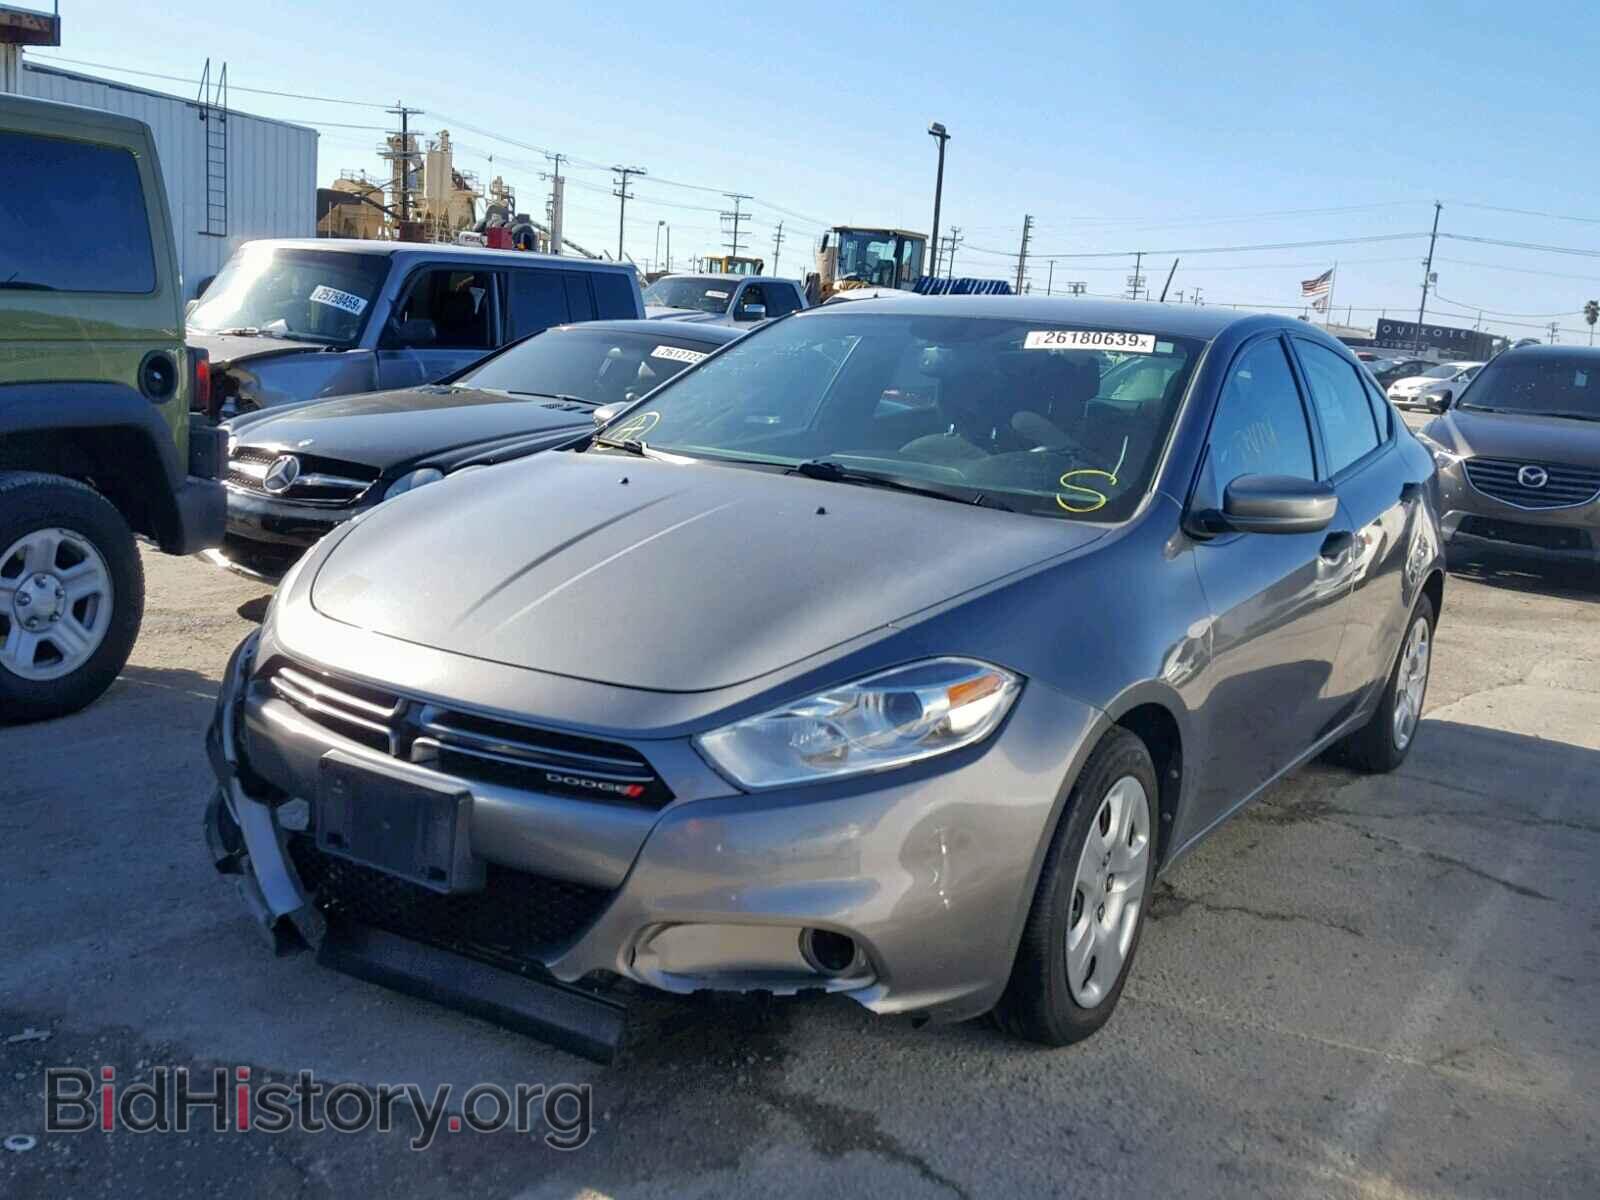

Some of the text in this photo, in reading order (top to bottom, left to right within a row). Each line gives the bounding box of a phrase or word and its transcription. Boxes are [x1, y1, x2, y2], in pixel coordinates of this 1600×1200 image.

[1382, 323, 1468, 339] QUIXOTE
[1056, 469, 1117, 512] S
[546, 773, 629, 795] DODGE
